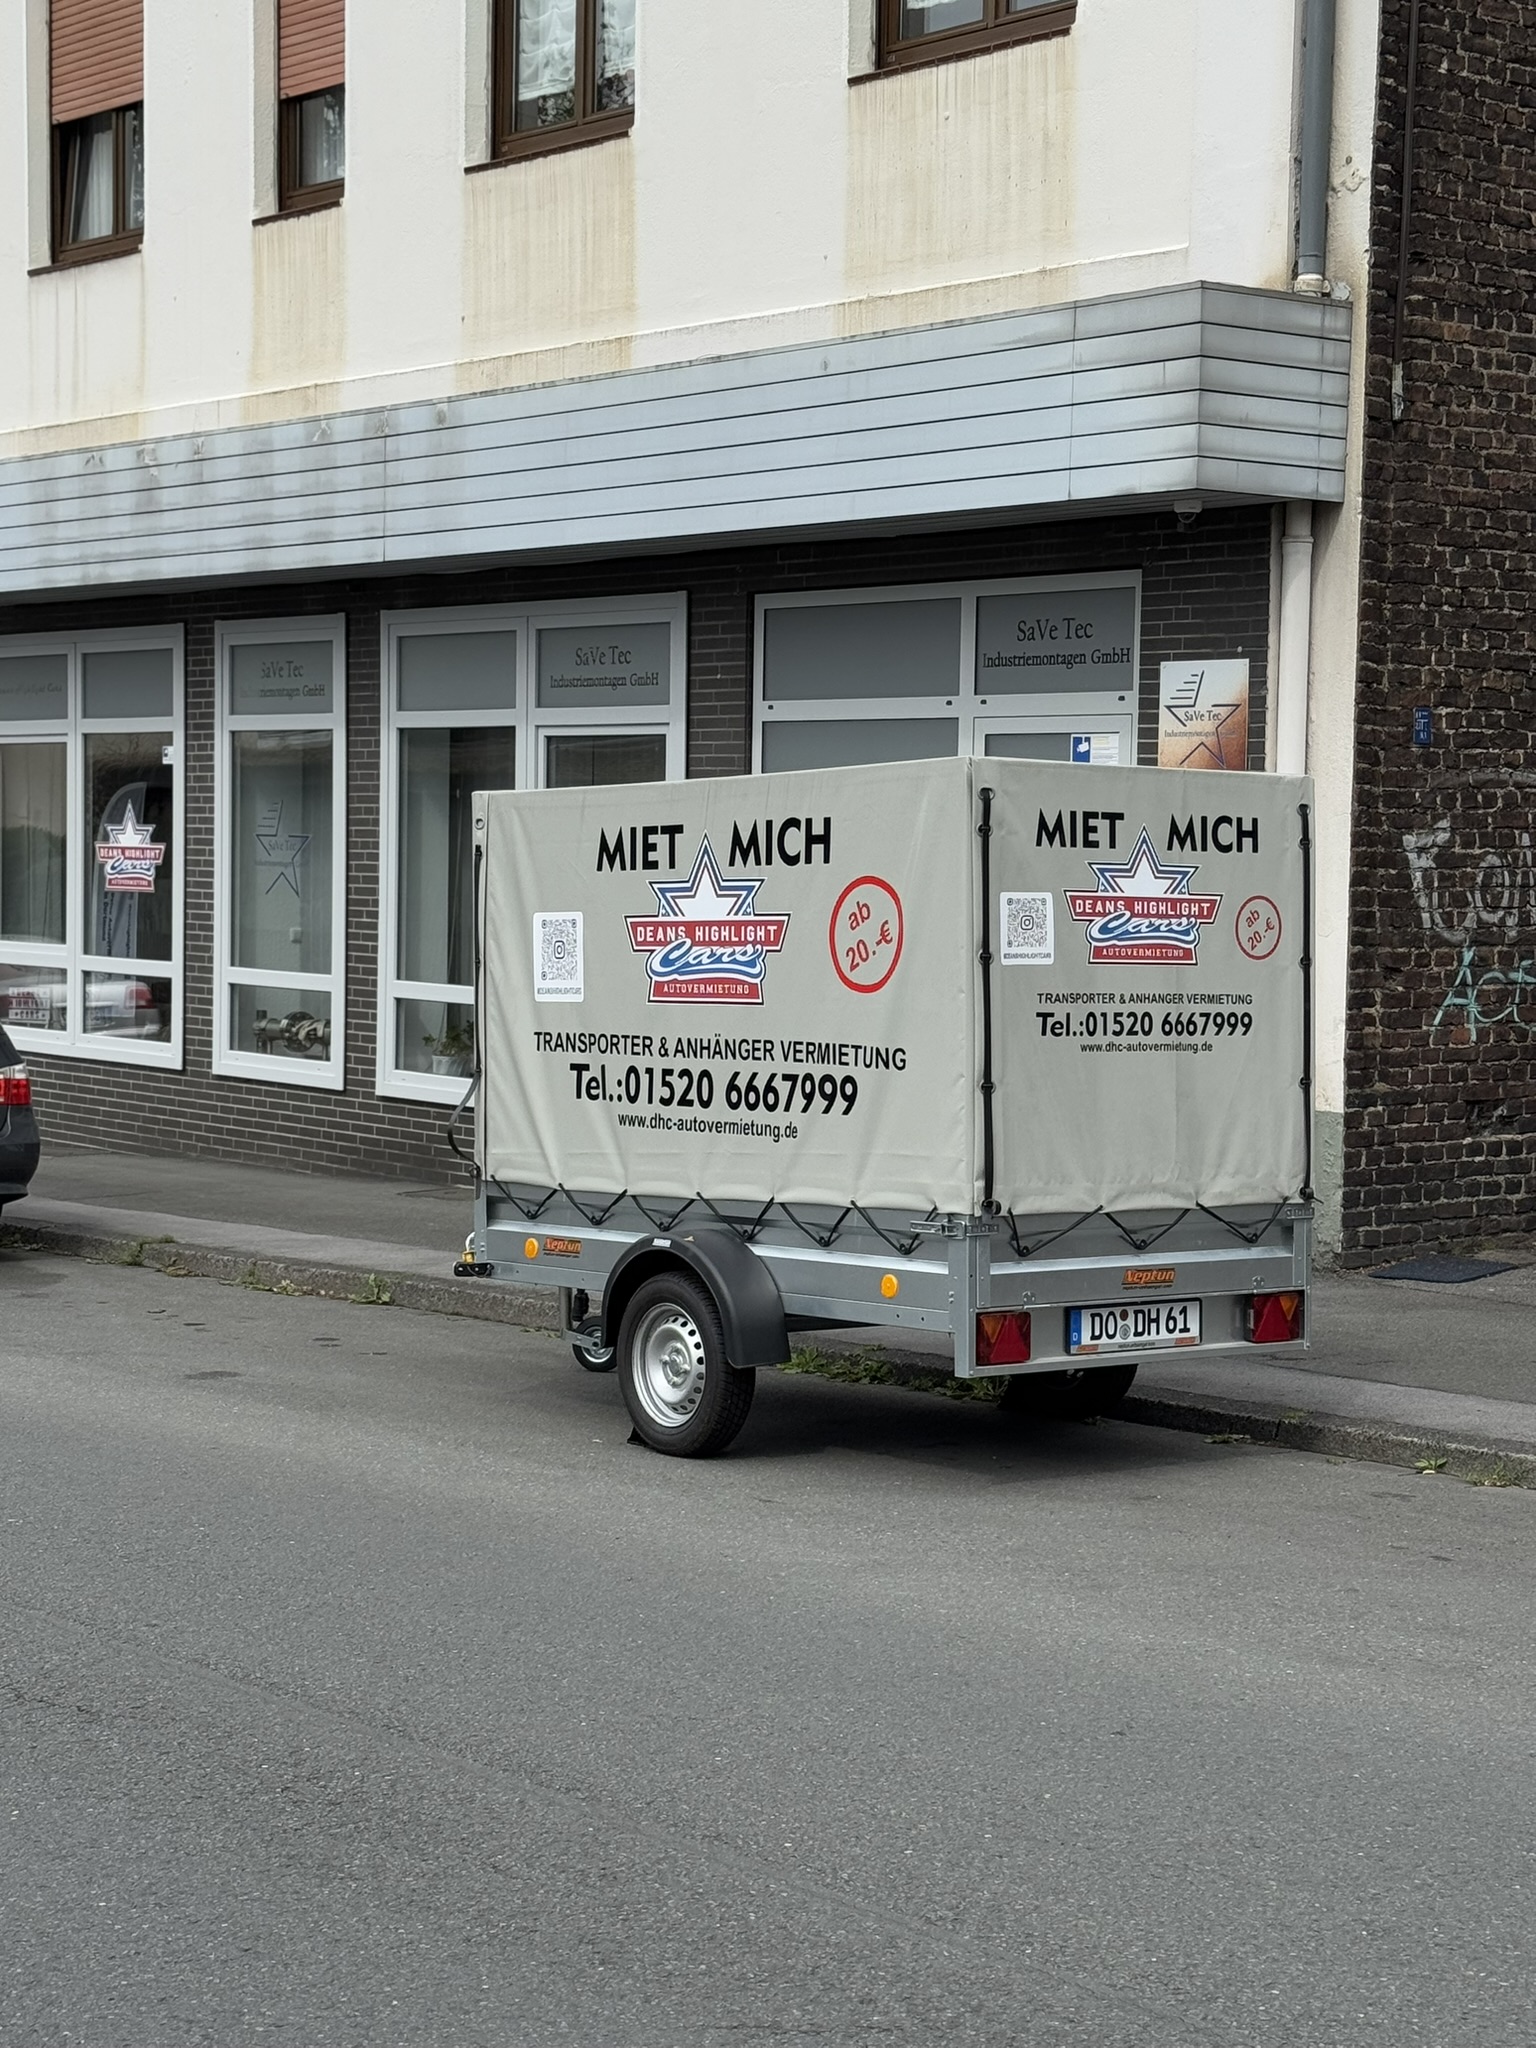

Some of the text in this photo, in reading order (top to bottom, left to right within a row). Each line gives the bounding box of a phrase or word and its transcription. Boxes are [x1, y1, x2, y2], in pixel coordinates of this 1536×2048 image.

[1016, 617, 1094, 642] SaVe Tec
[575, 645, 632, 666] SaVe Tec
[983, 647, 1131, 669] Industriemontagen GmbH
[285, 660, 304, 678] Tec
[302, 684, 326, 697] GmbH
[550, 671, 659, 691] Industriemontagen GmbH
[1183, 710, 1222, 722] SaVe Tec
[1035, 807, 1259, 853] MIET MICH
[596, 816, 832, 873] MIET MICH
[848, 900, 871, 931] ab
[1075, 900, 1211, 916] DEANS HIGHLIGHT
[1089, 910, 1196, 940] Cars
[1246, 910, 1260, 928] ab
[636, 926, 778, 942] DEANS HIGHLIGHT
[650, 937, 763, 975] Cars
[1102, 948, 1184, 957] AUTOVERMIETUNG
[663, 984, 749, 995] AUTOVERMIETUNG
[1037, 993, 1115, 1005] TRANSPORTER
[1119, 993, 1126, 1005] &
[1186, 993, 1253, 1005] VERMIETUNG
[1161, 1011, 1253, 1037] 6667999
[533, 1031, 907, 1071] TRANSPORTER & ANHÄNGER VERMIETUNG
[1080, 1041, 1213, 1054] www.dhc-autovermietung.de
[725, 1071, 858, 1115] 6667999
[617, 1112, 798, 1143] www.dhc-autovermietung.de
[545, 1238, 582, 1252] Neptun
[1124, 1269, 1175, 1284] Neptun
[1089, 1310, 1118, 1341] DO
[1072, 1332, 1078, 1341] D
